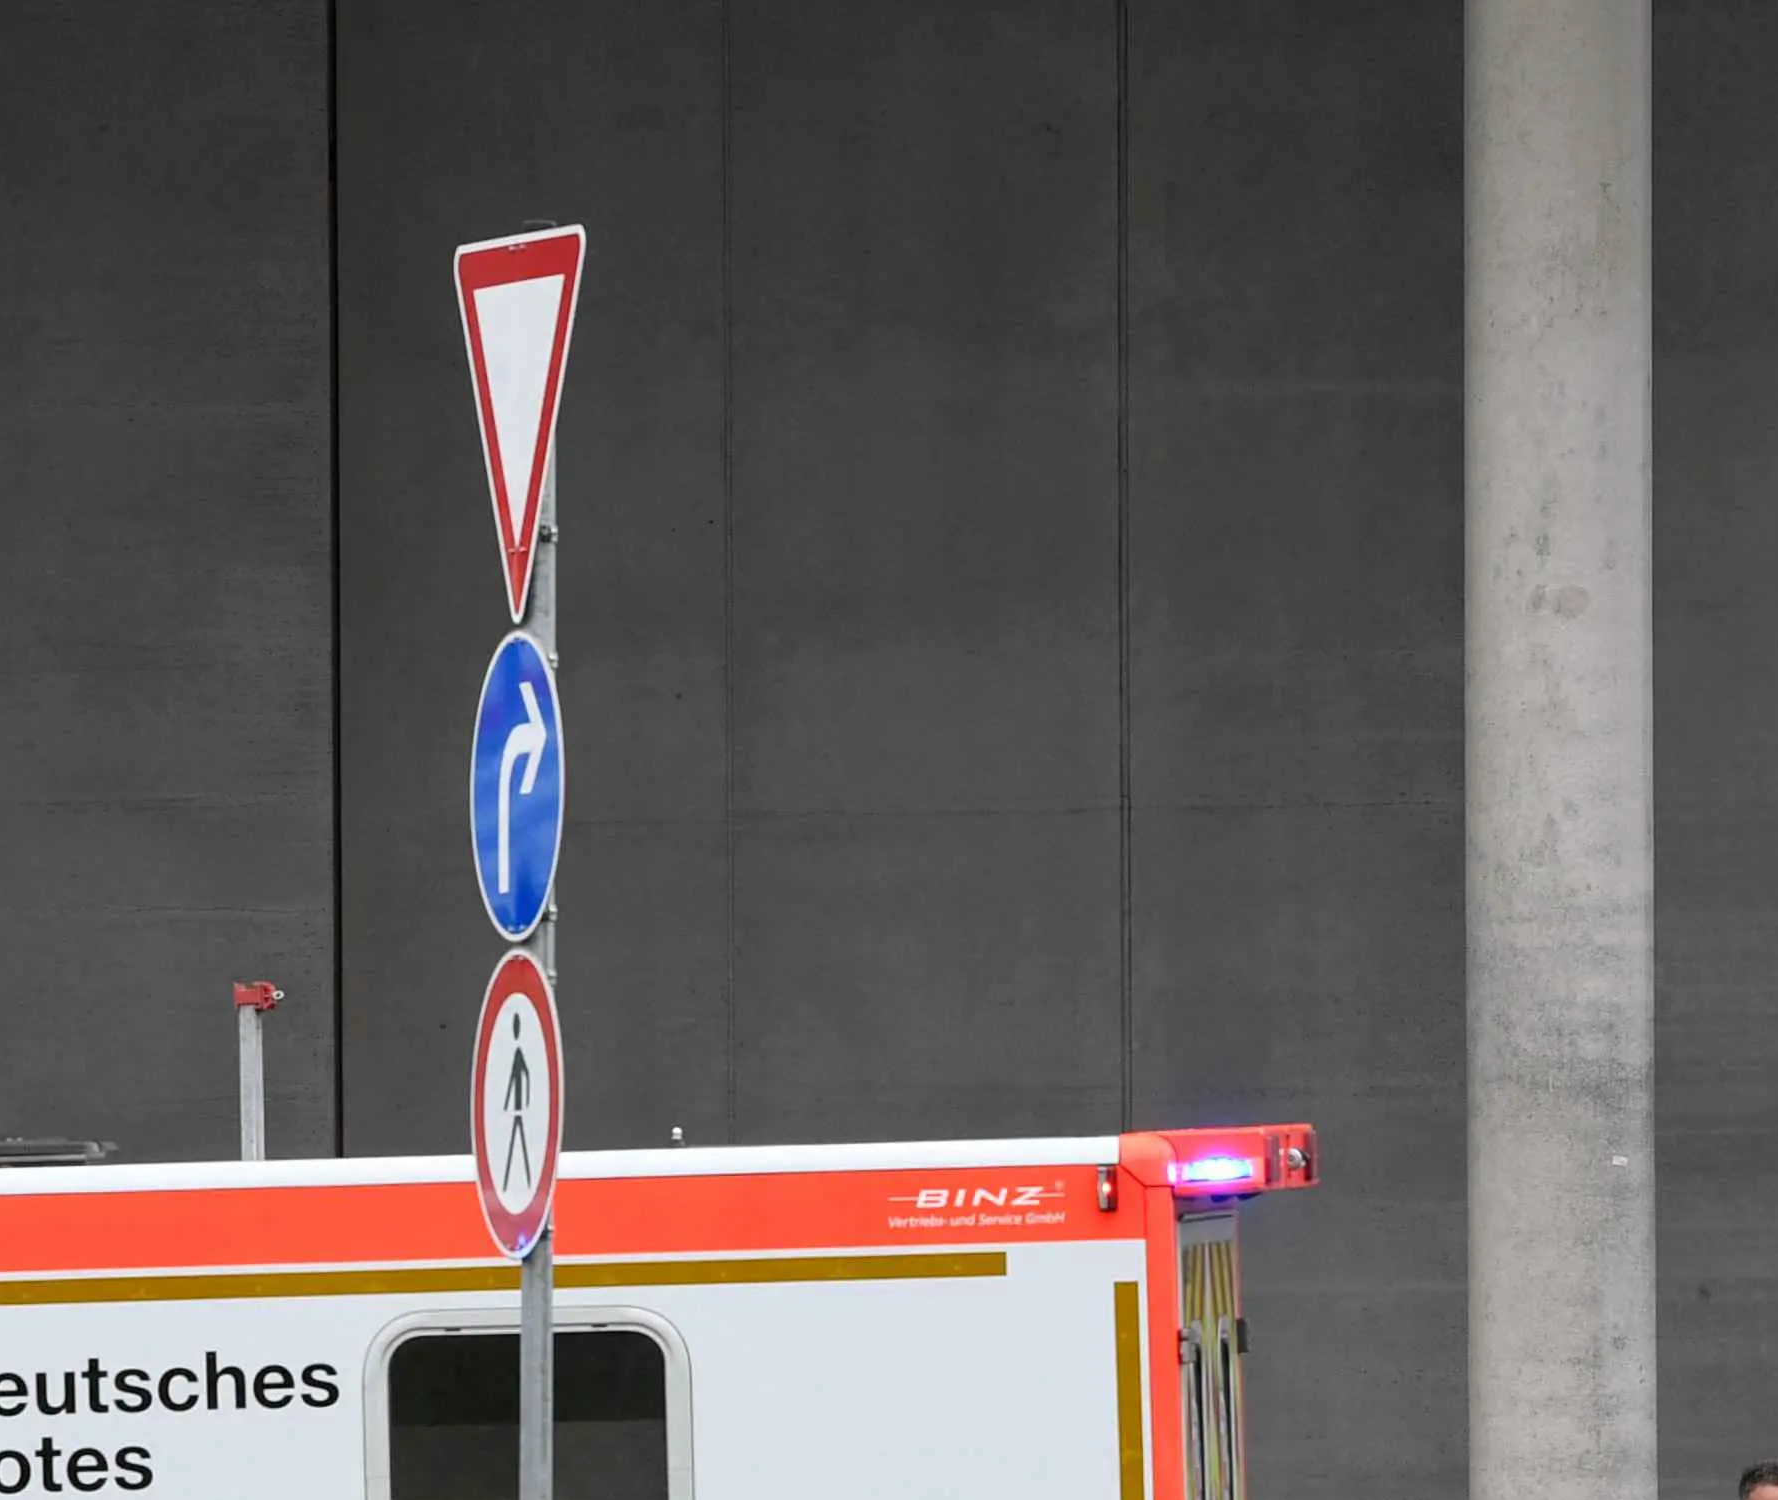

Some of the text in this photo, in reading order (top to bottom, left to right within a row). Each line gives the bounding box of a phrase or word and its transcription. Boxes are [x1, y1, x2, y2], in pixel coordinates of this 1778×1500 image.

[915, 1185, 1045, 1210] BINZ
[950, 1212, 976, 1227] und
[979, 1211, 1023, 1227] Service
[1025, 1210, 1067, 1225] GmbH
